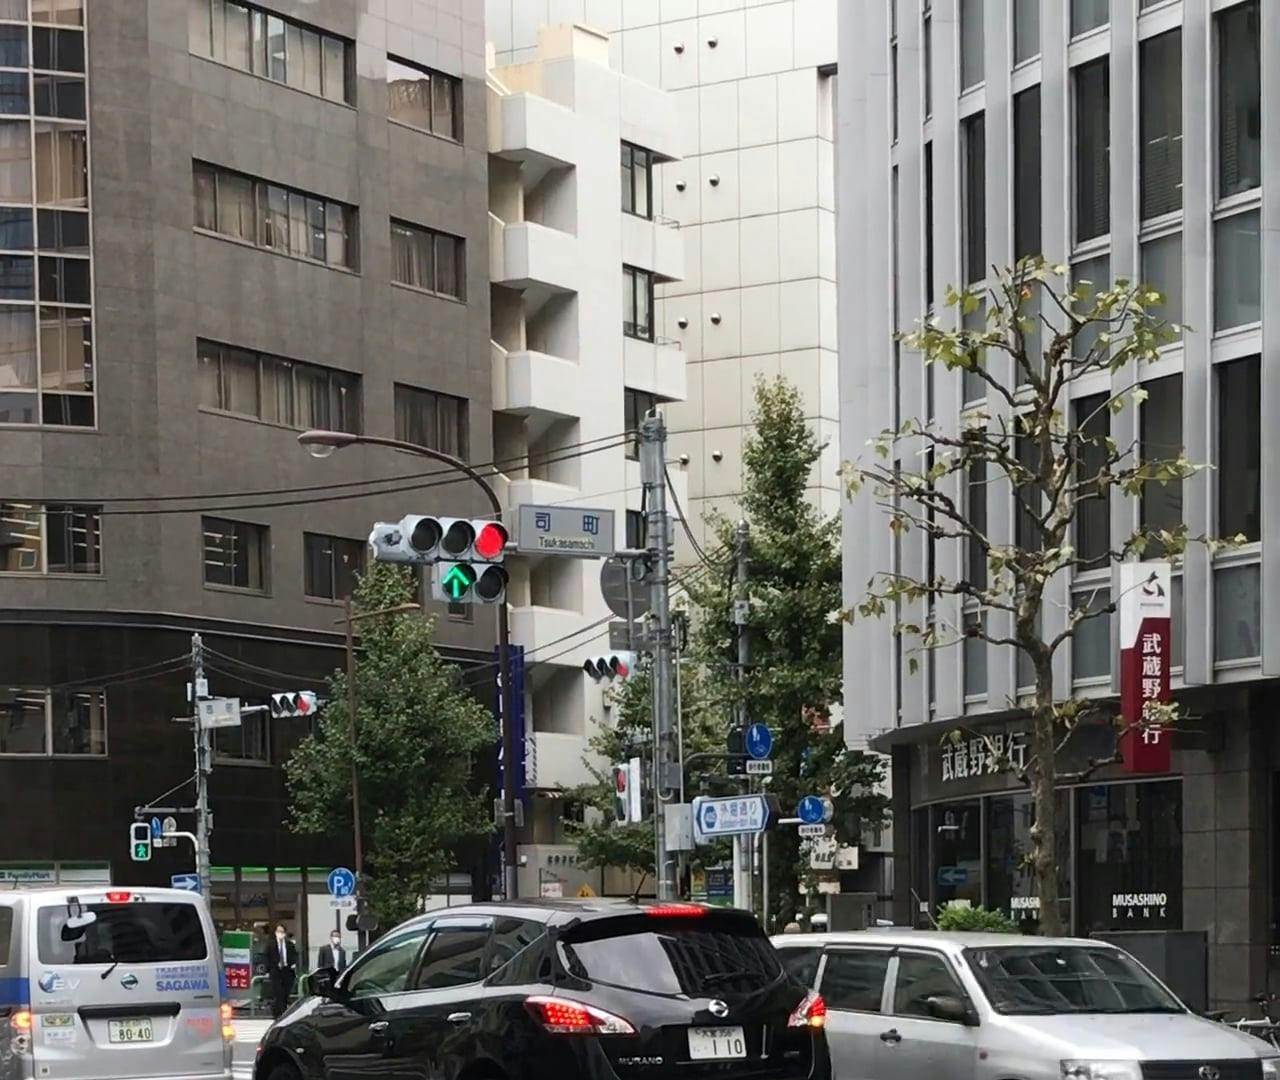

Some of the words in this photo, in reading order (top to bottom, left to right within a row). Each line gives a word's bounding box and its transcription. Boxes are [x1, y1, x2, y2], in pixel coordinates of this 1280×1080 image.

[1010, 896, 1040, 909] MUSASH
[1112, 893, 1167, 906] MUSASHINO
[156, 979, 209, 992] SAGAWA
[619, 1056, 663, 1065] MURANO
